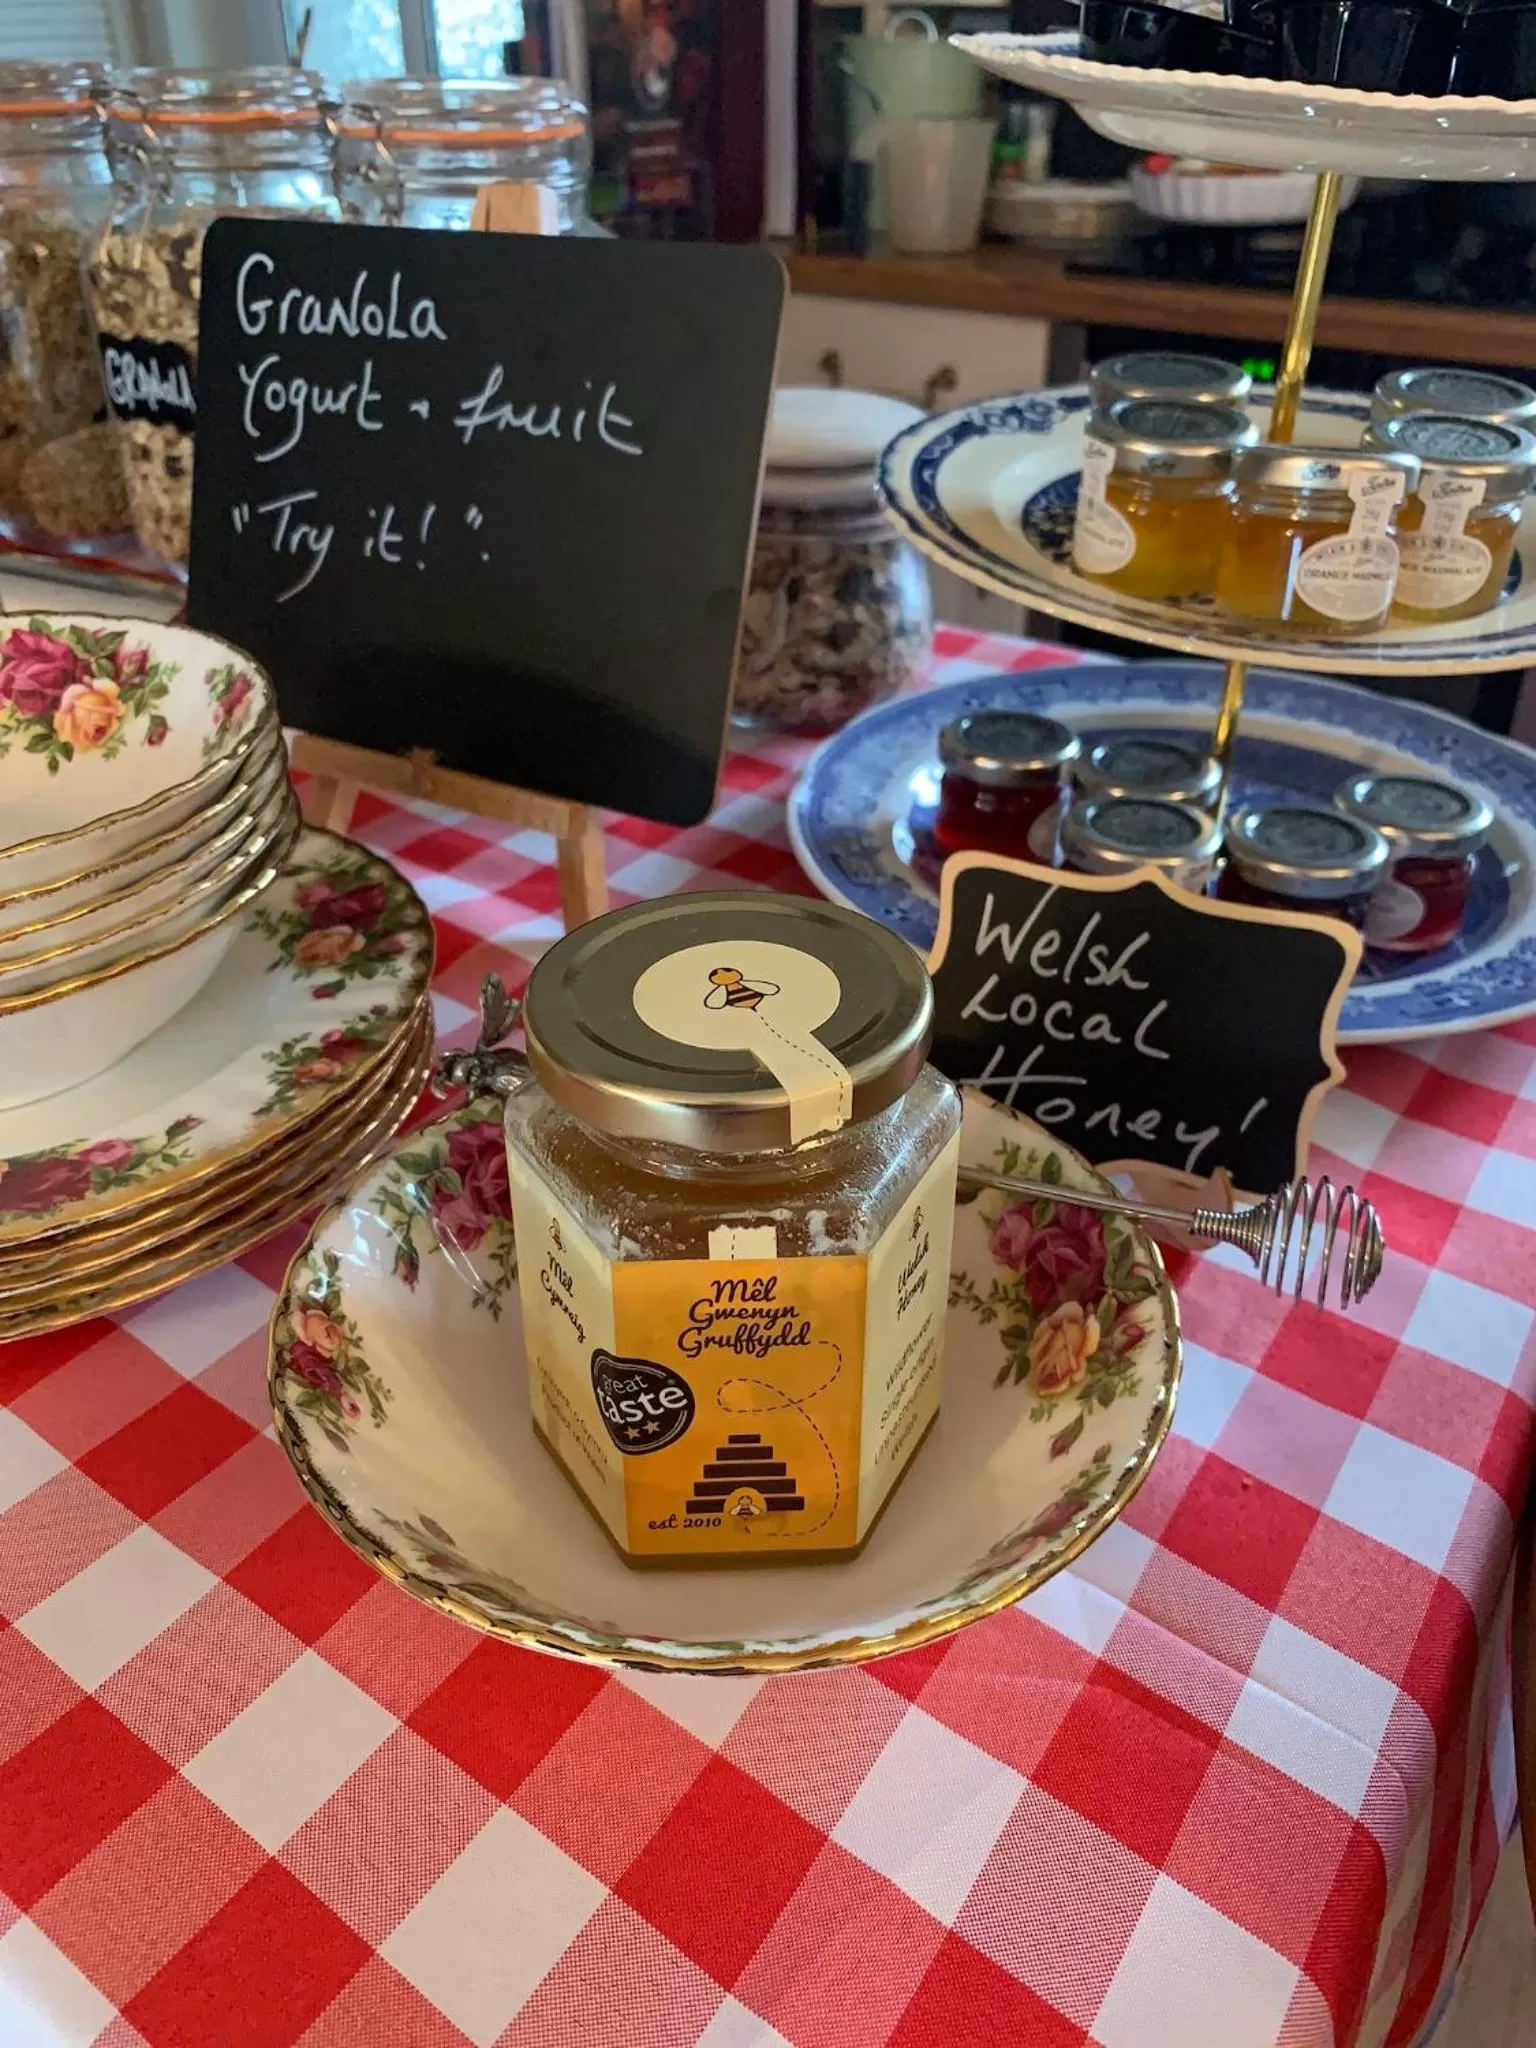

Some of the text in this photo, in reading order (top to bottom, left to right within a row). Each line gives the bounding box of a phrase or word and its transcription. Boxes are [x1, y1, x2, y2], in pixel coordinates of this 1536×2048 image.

[238, 354, 383, 463] Yogurt
[975, 884, 1150, 989] Welsh
[711, 1276, 778, 1304] Mêl
[689, 1299, 800, 1331] Gwenyn
[677, 1321, 812, 1358] Gruffydd
[597, 1386, 688, 1424] taste
[648, 1513, 722, 1530] est 2010
